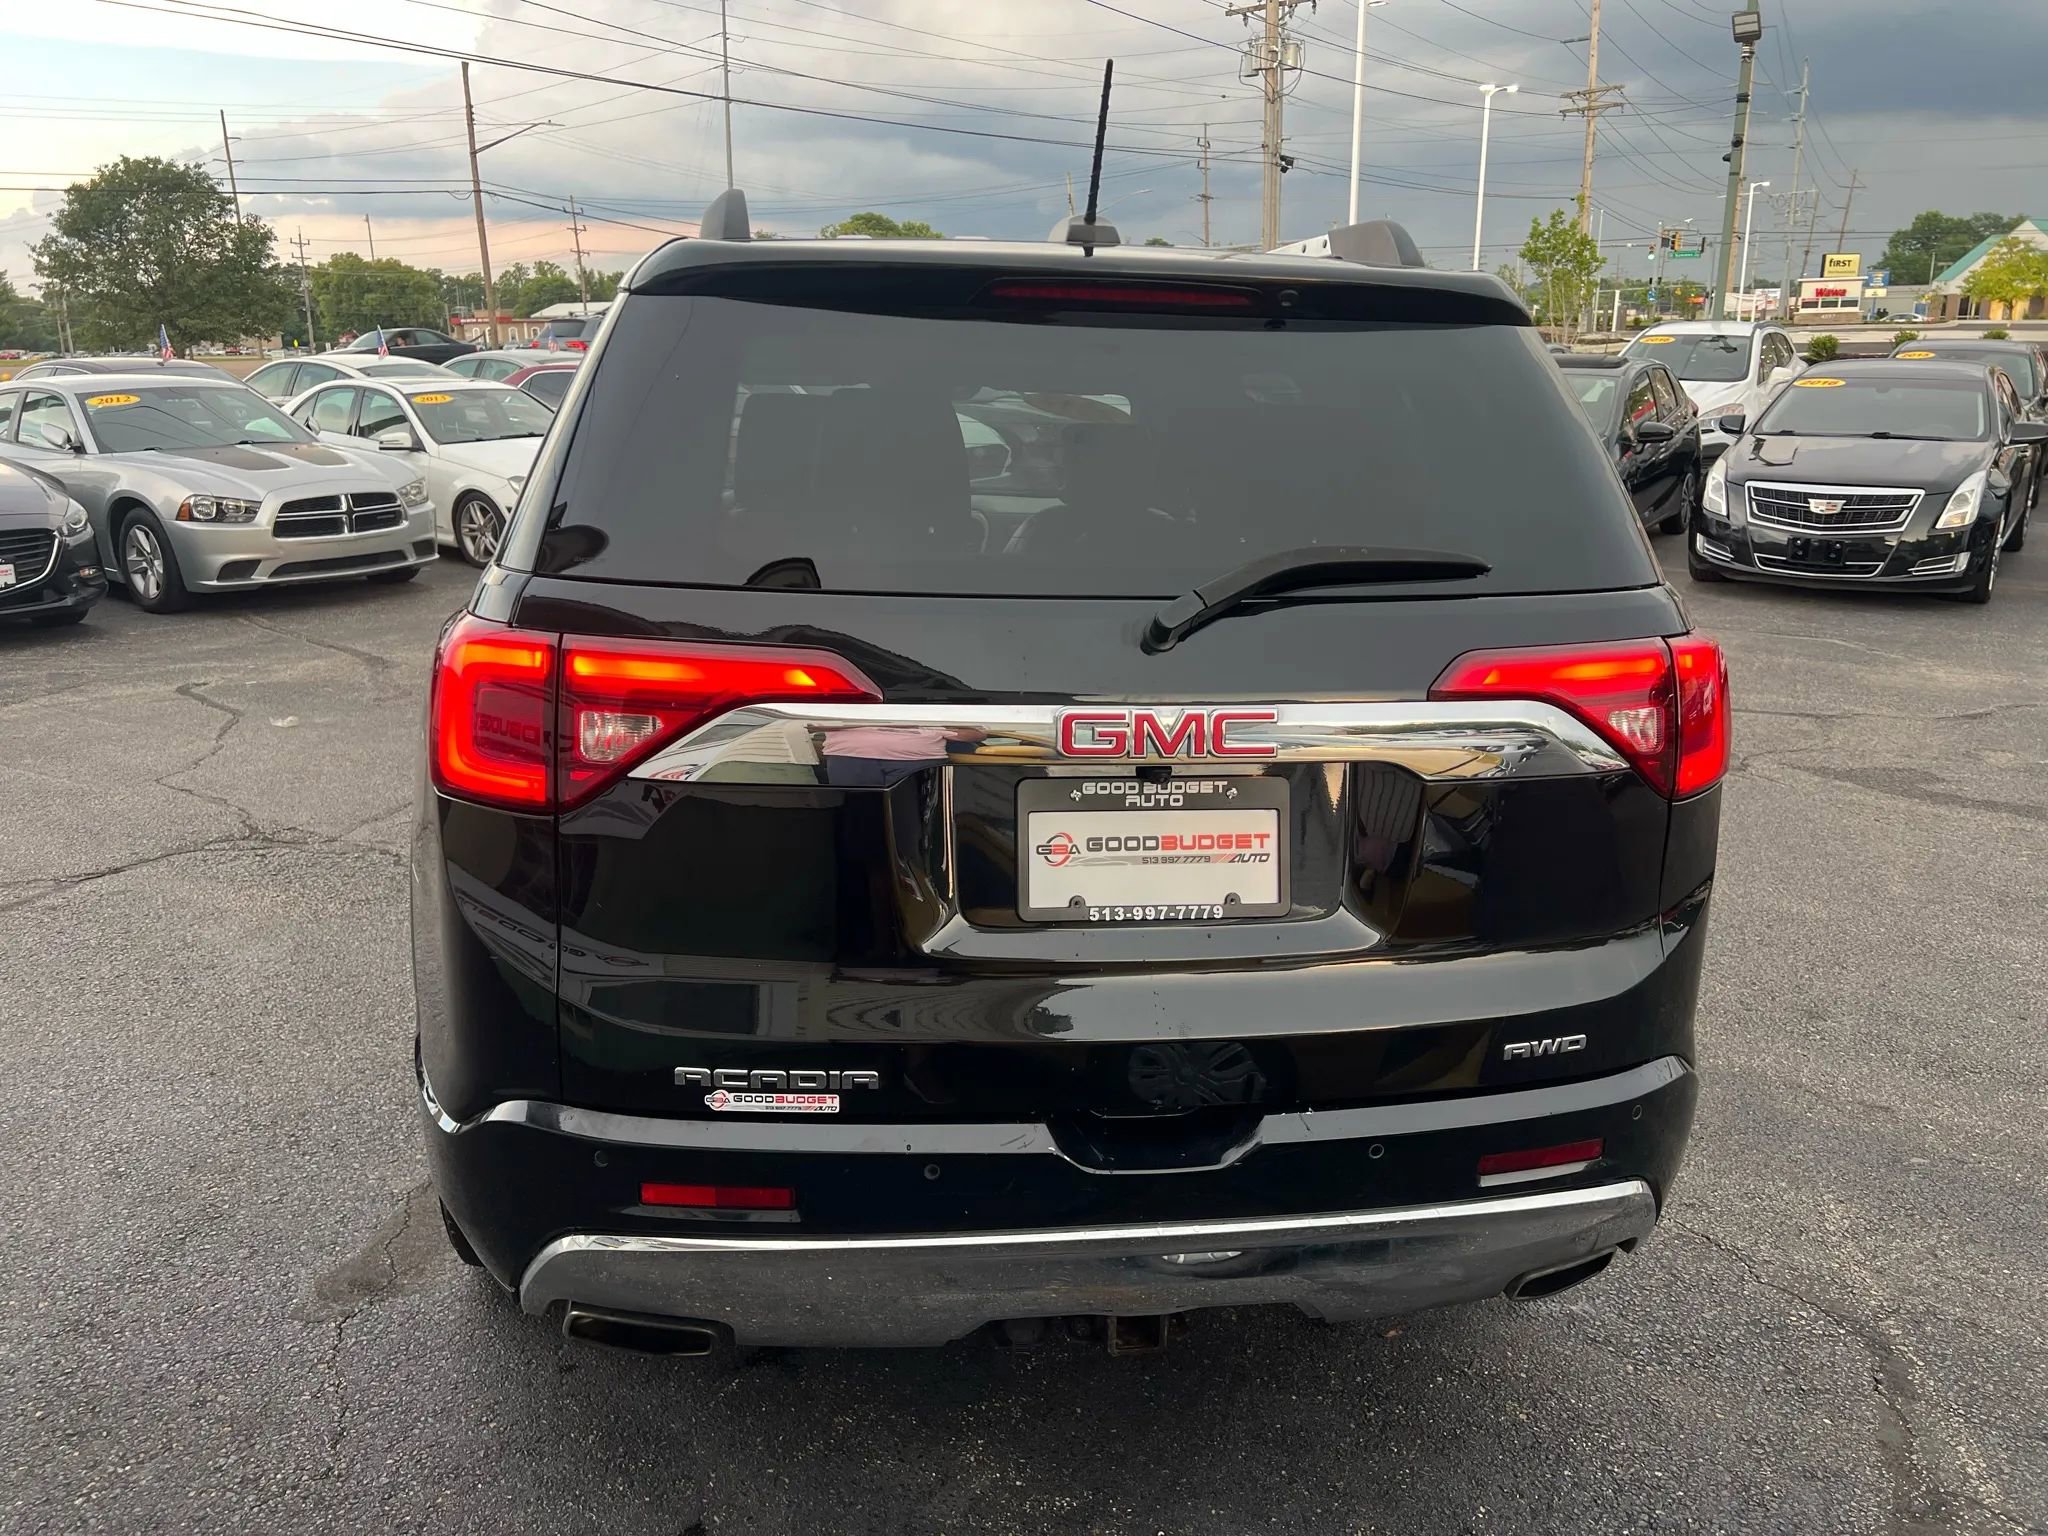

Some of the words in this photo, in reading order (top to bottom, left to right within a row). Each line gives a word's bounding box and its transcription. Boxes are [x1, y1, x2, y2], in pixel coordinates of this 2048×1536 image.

[97, 396, 132, 405] 2012
[1056, 706, 1279, 759] GMC
[1082, 782, 1139, 795] GOOD
[1143, 781, 1228, 794] BUDGET
[1125, 794, 1184, 807] AUTO
[1228, 853, 1271, 864] AUTO
[1089, 905, 1224, 921] 513-997-7779
[1503, 1034, 1587, 1061] AWD
[674, 1066, 880, 1090] ACADIA
